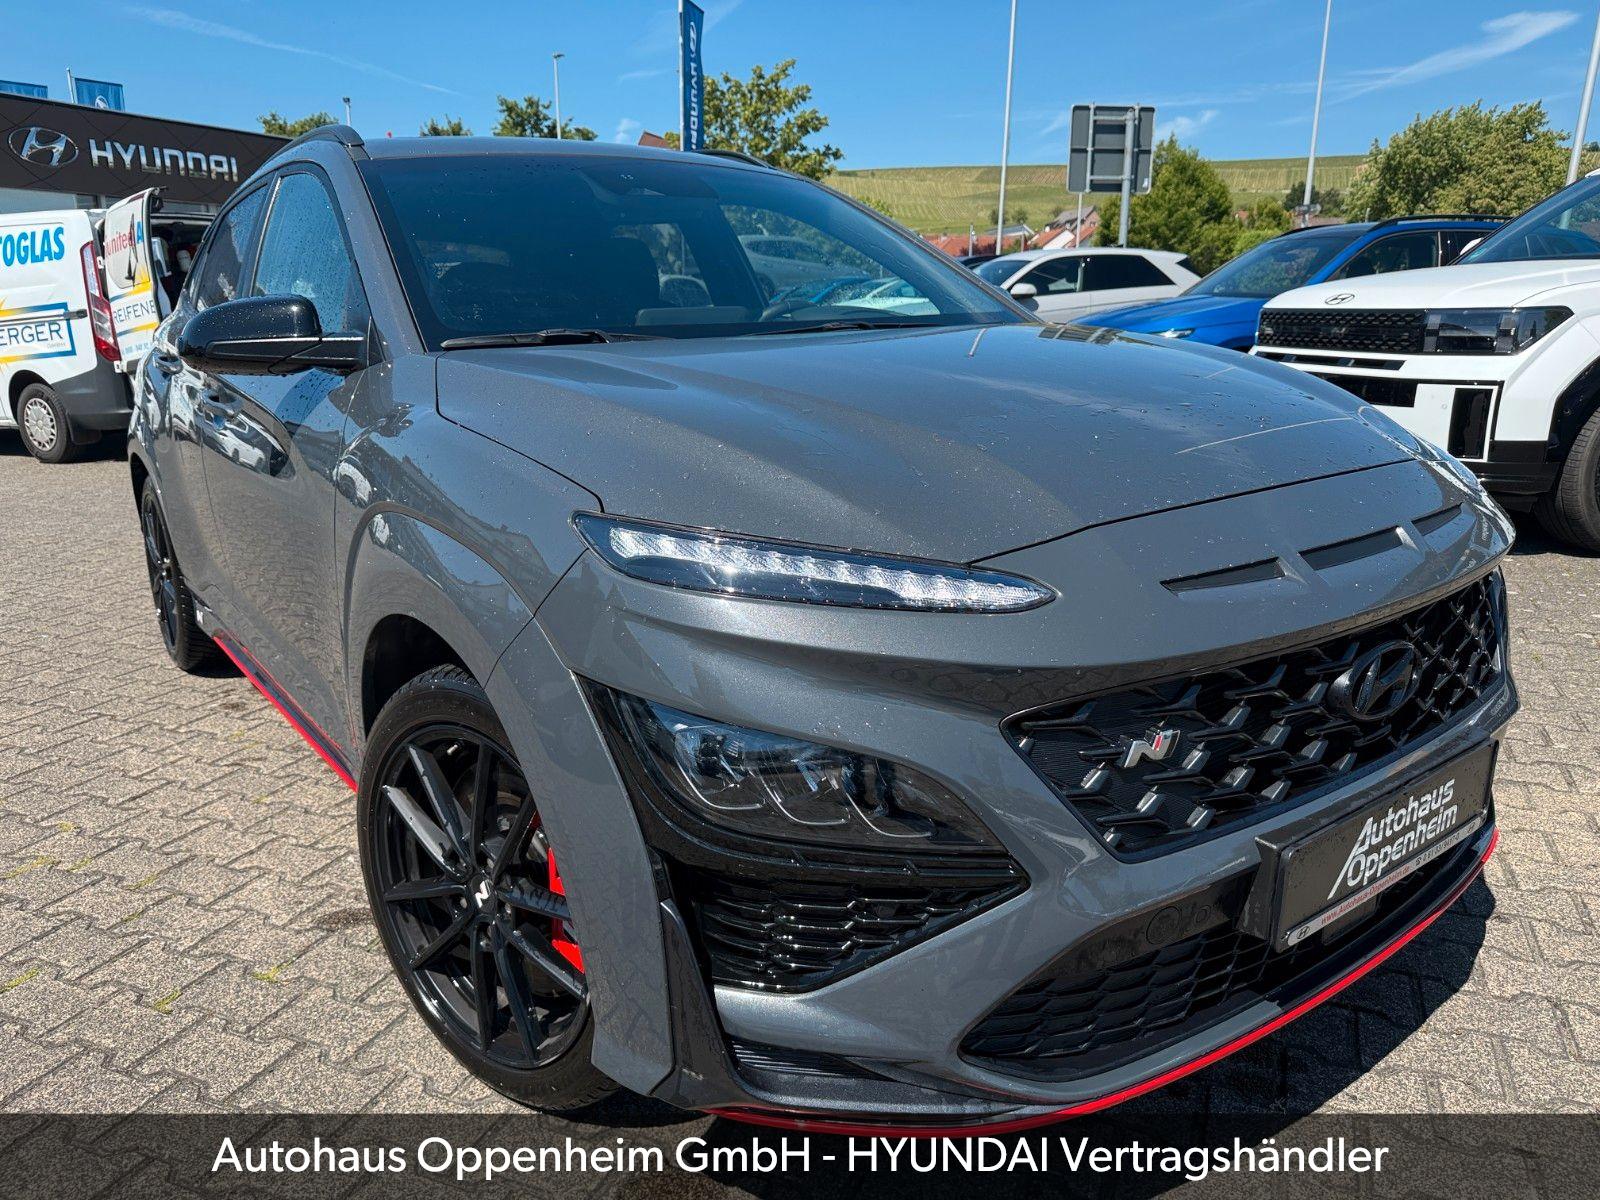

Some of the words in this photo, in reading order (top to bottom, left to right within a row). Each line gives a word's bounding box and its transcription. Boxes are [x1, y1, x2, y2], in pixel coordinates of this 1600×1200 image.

[89, 138, 239, 182] HYUNDAI
[0, 226, 65, 267] OGLAS
[1346, 804, 1458, 887] Oppenheim
